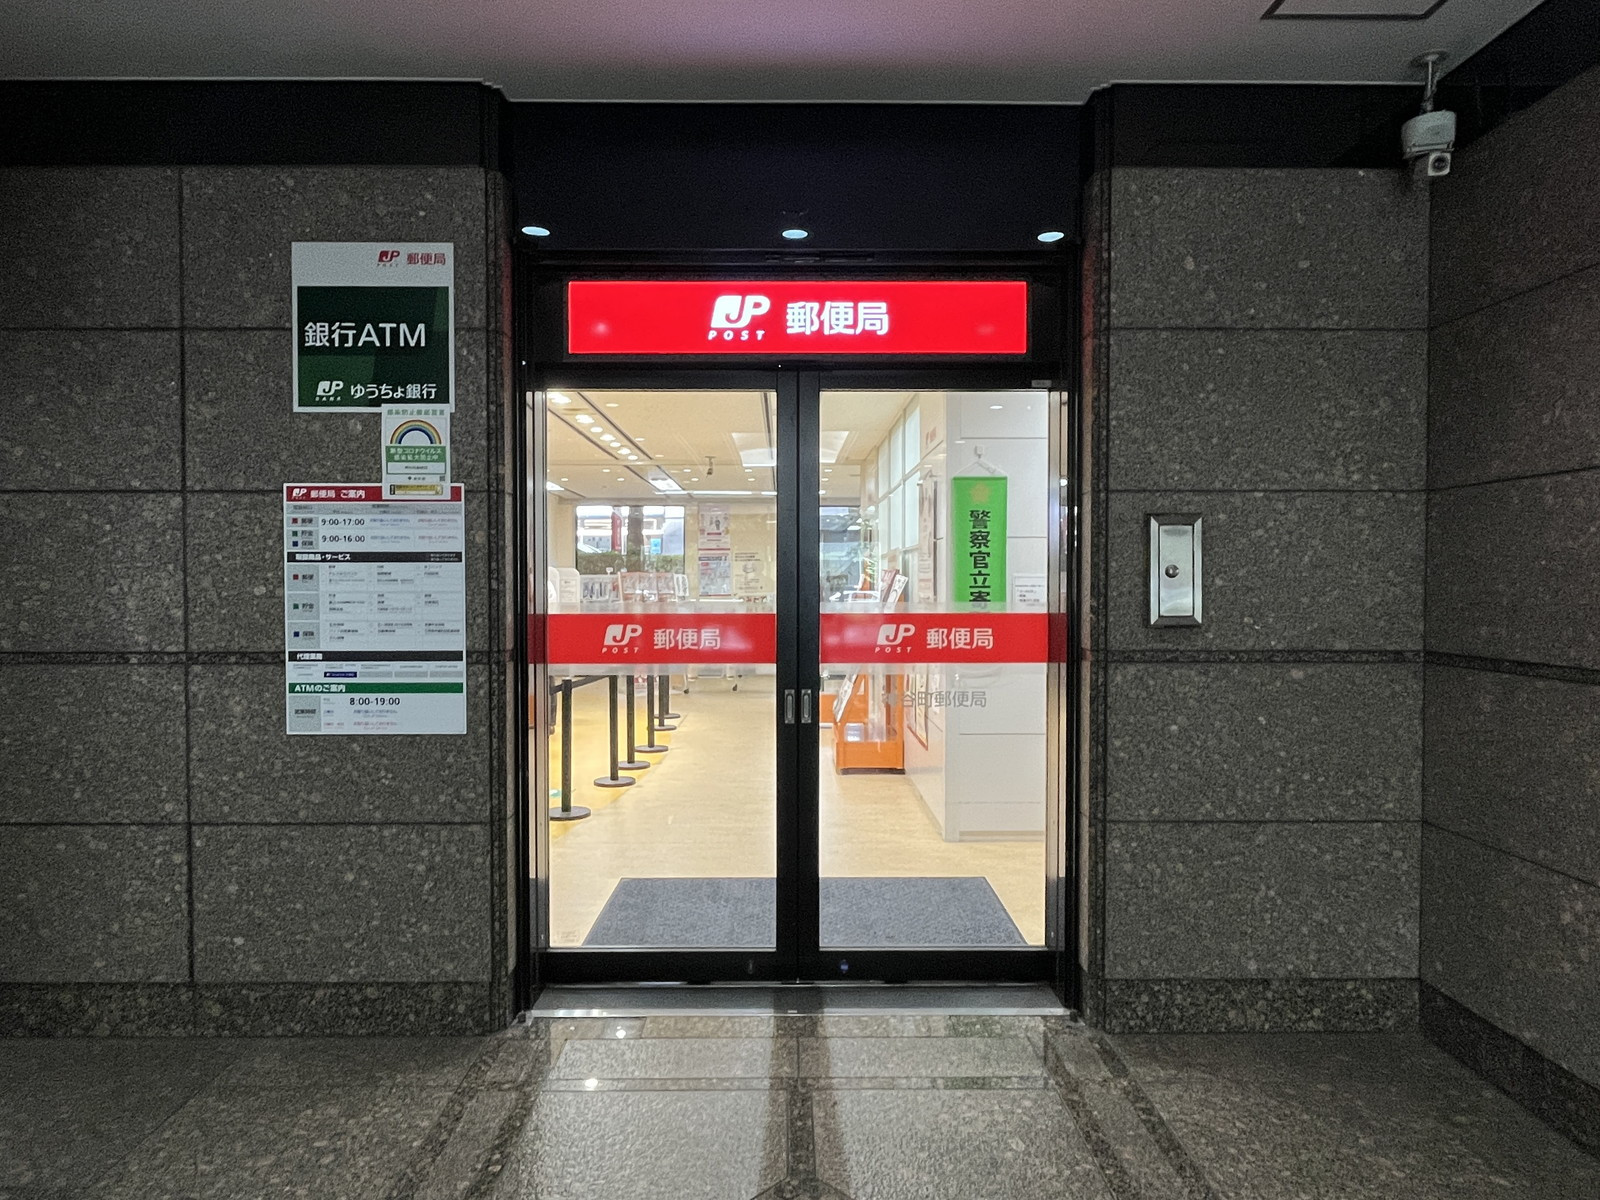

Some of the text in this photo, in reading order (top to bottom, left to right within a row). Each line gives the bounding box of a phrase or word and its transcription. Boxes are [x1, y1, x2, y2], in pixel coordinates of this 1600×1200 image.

[407, 252, 446, 266] 郵便局
[786, 301, 889, 336] 郵便局
[304, 322, 426, 347] 銀行ATM
[708, 330, 766, 341] POST
[350, 383, 437, 399] ゆうちょ銀行
[969, 509, 991, 613] 警察官立寄
[653, 628, 721, 650] 郵便局
[926, 627, 994, 650] 郵便局
[349, 697, 401, 706] 8:00-19:00
[883, 690, 987, 708] 谷町郵便局
